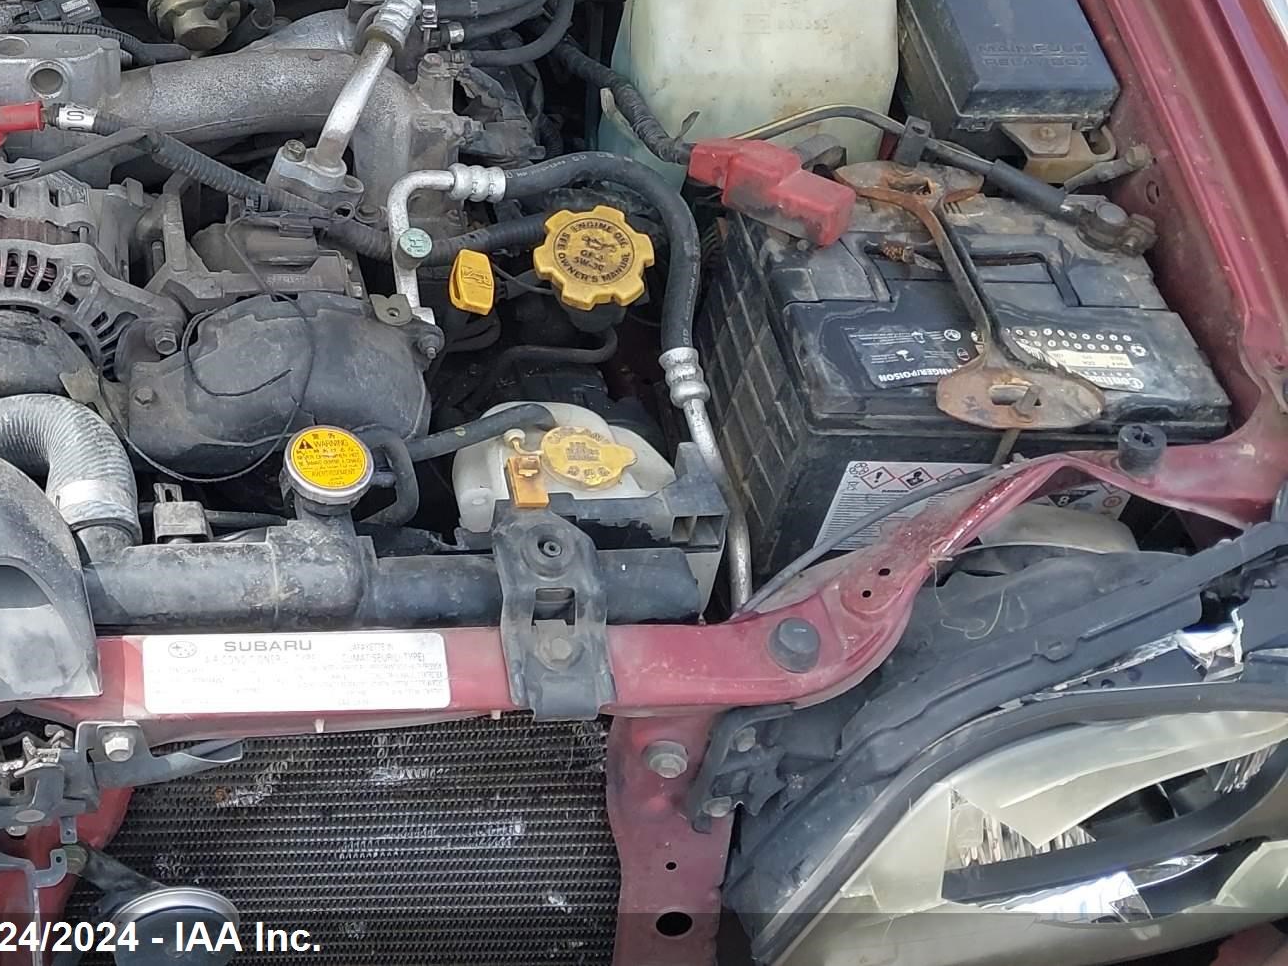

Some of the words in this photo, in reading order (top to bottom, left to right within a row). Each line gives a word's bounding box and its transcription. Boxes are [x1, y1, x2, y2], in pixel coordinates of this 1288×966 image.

[571, 221, 614, 234] ENGINE
[556, 232, 571, 251] SEE
[557, 252, 600, 283] OWNER'S
[600, 251, 632, 284] MANUAL
[223, 640, 312, 652] SUBARU
